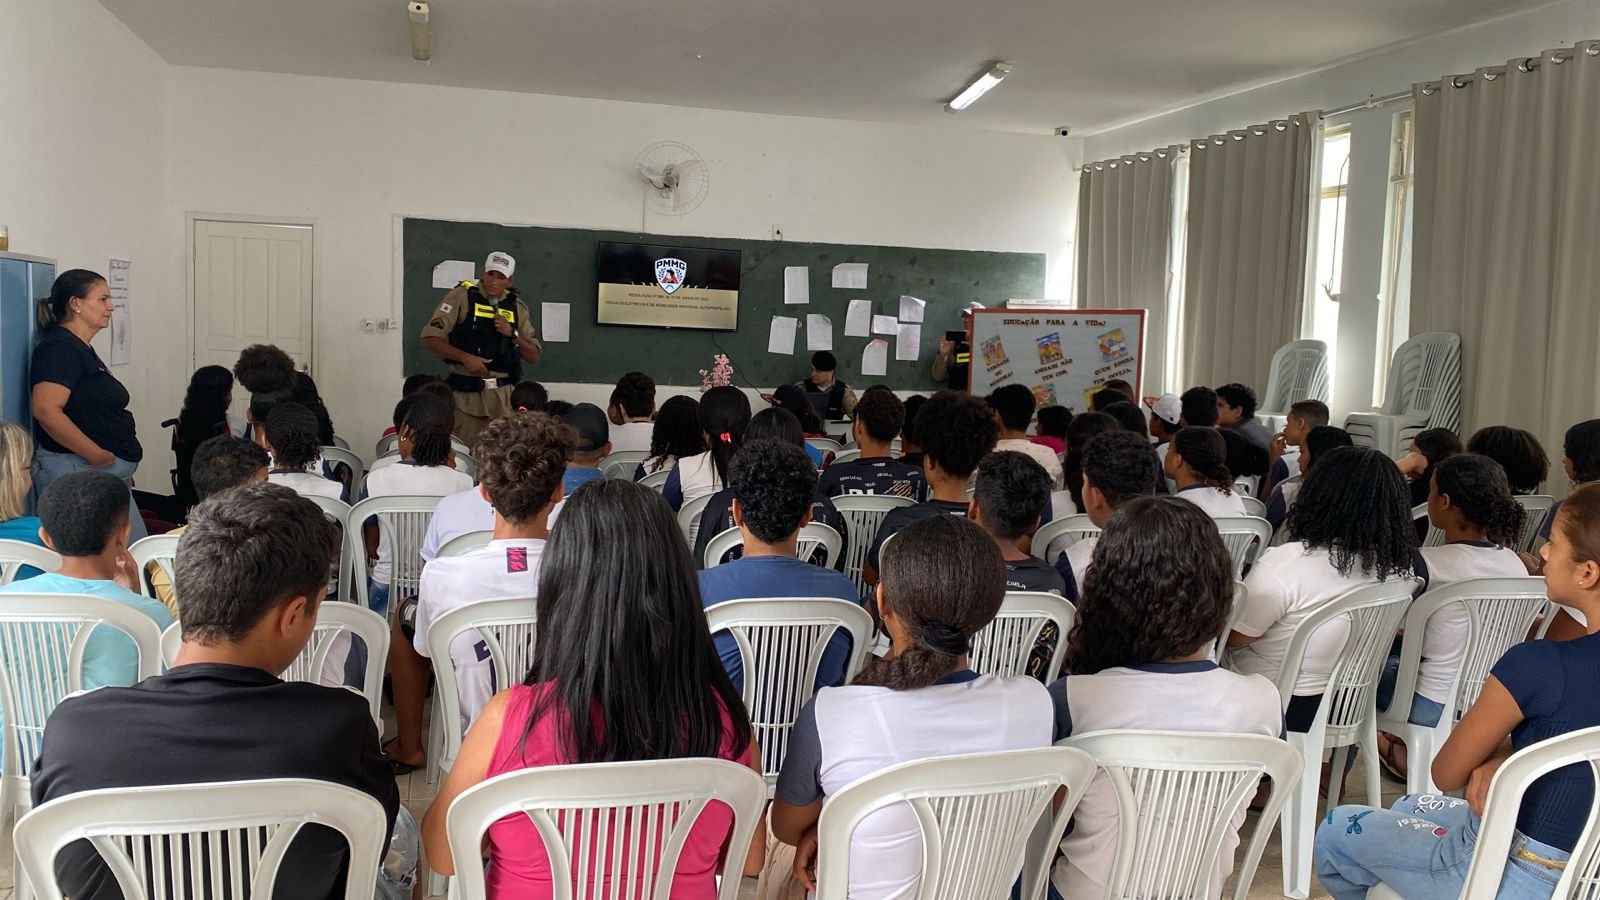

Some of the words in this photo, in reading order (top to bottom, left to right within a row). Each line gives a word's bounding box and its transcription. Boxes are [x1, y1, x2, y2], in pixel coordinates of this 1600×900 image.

[656, 259, 686, 270] PMMG
[1003, 318, 1040, 327] EDUCAÇÃO
[1085, 319, 1106, 327] VIDA!
[1060, 358, 1073, 367] NÃO
[1094, 365, 1111, 376] QUEM
[1093, 376, 1106, 385] TEM
